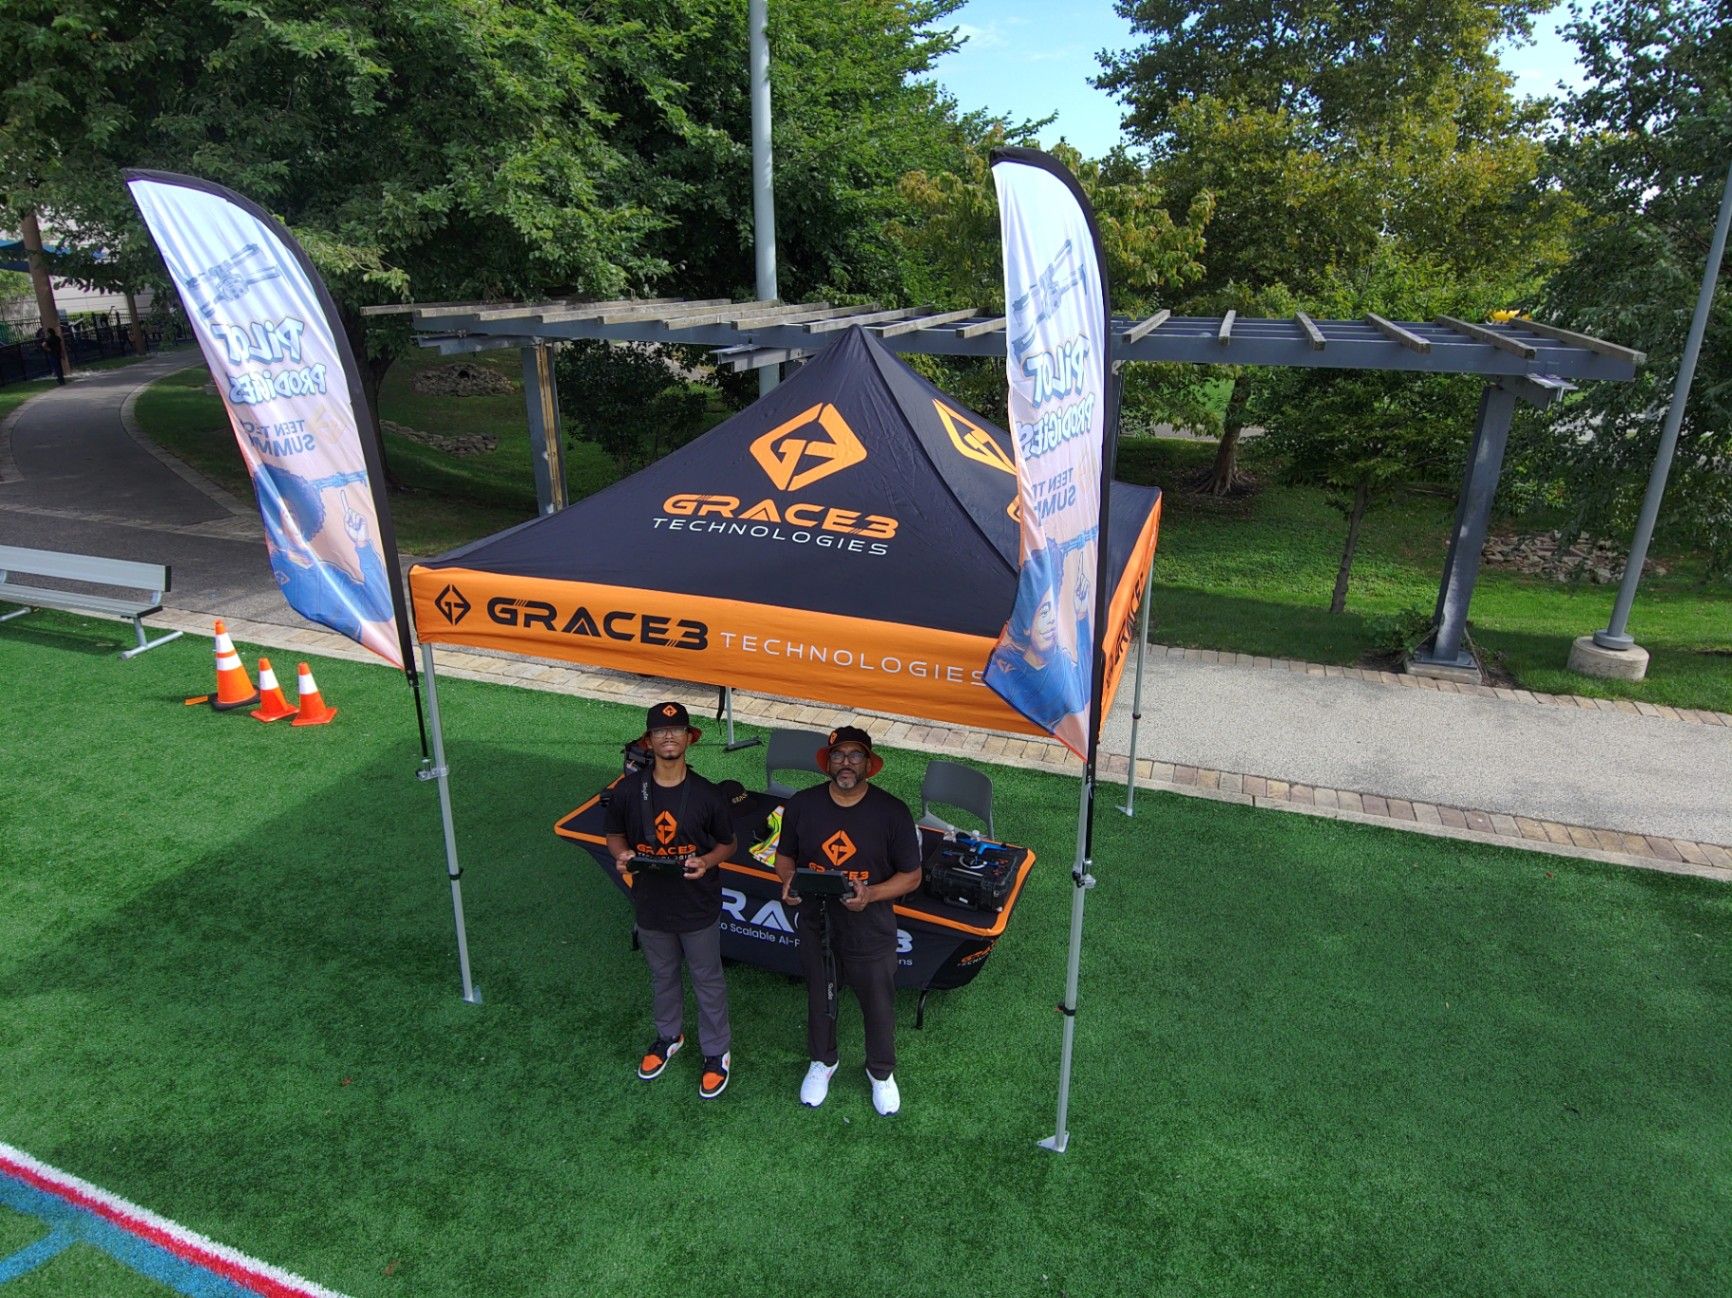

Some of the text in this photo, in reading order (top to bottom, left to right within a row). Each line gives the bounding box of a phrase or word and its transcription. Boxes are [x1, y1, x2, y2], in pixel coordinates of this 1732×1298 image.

[652, 518, 889, 556] TECHNOLOGIES
[663, 494, 899, 540] GRACE3
[486, 597, 987, 687] GRACE3 TECHNOLOGIES
[730, 923, 776, 942] Scalable
